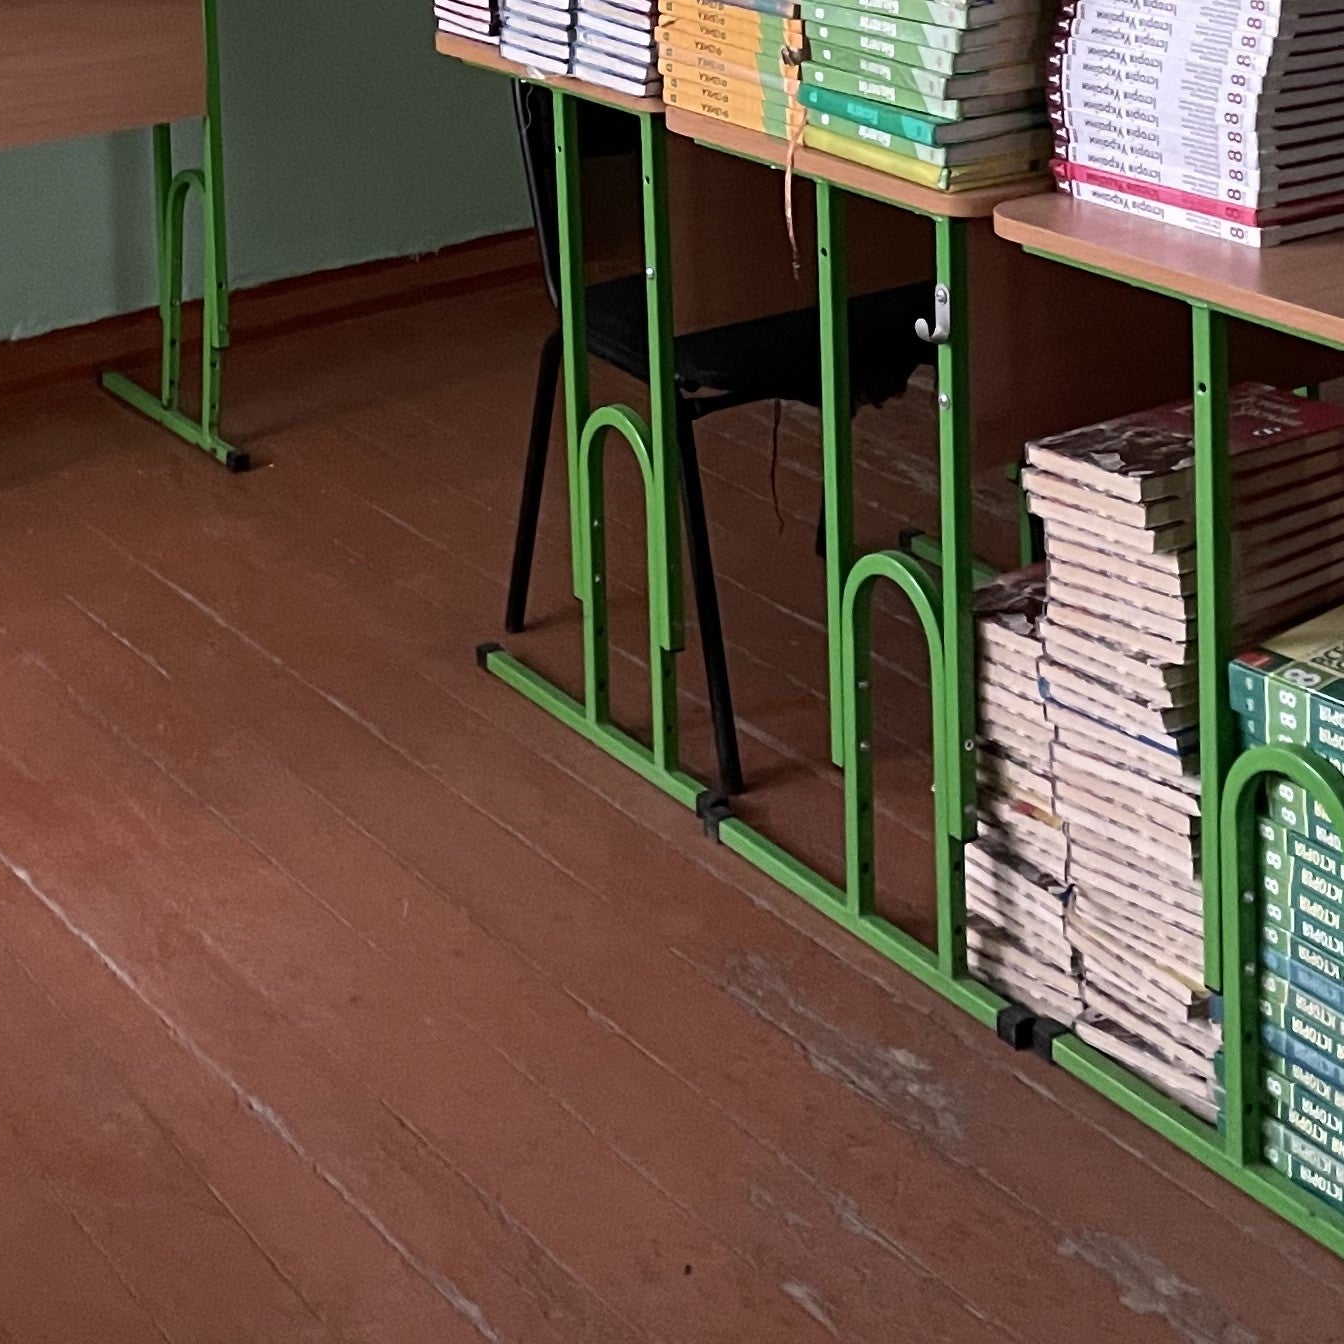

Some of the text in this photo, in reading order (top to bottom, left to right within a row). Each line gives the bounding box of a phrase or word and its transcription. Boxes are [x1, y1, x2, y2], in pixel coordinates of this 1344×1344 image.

[1250, 0, 1264, 11] 8
[1247, 17, 1262, 29] 8
[1241, 36, 1256, 48] 8
[1237, 55, 1251, 67] 8
[1231, 74, 1245, 86] 8
[1227, 92, 1242, 104] 8
[1224, 113, 1239, 124] 8
[1228, 131, 1242, 143] 8
[1228, 150, 1242, 162] 8
[1229, 169, 1243, 181] 8
[1227, 189, 1241, 200] 8
[1230, 227, 1244, 239] 8
[1283, 668, 1321, 687] 8
[1279, 690, 1296, 708] 8
[1280, 712, 1296, 729] 8
[1281, 807, 1296, 825] 8
[1266, 850, 1281, 869] 8
[1264, 876, 1279, 895] 8
[1267, 904, 1282, 921] 8
